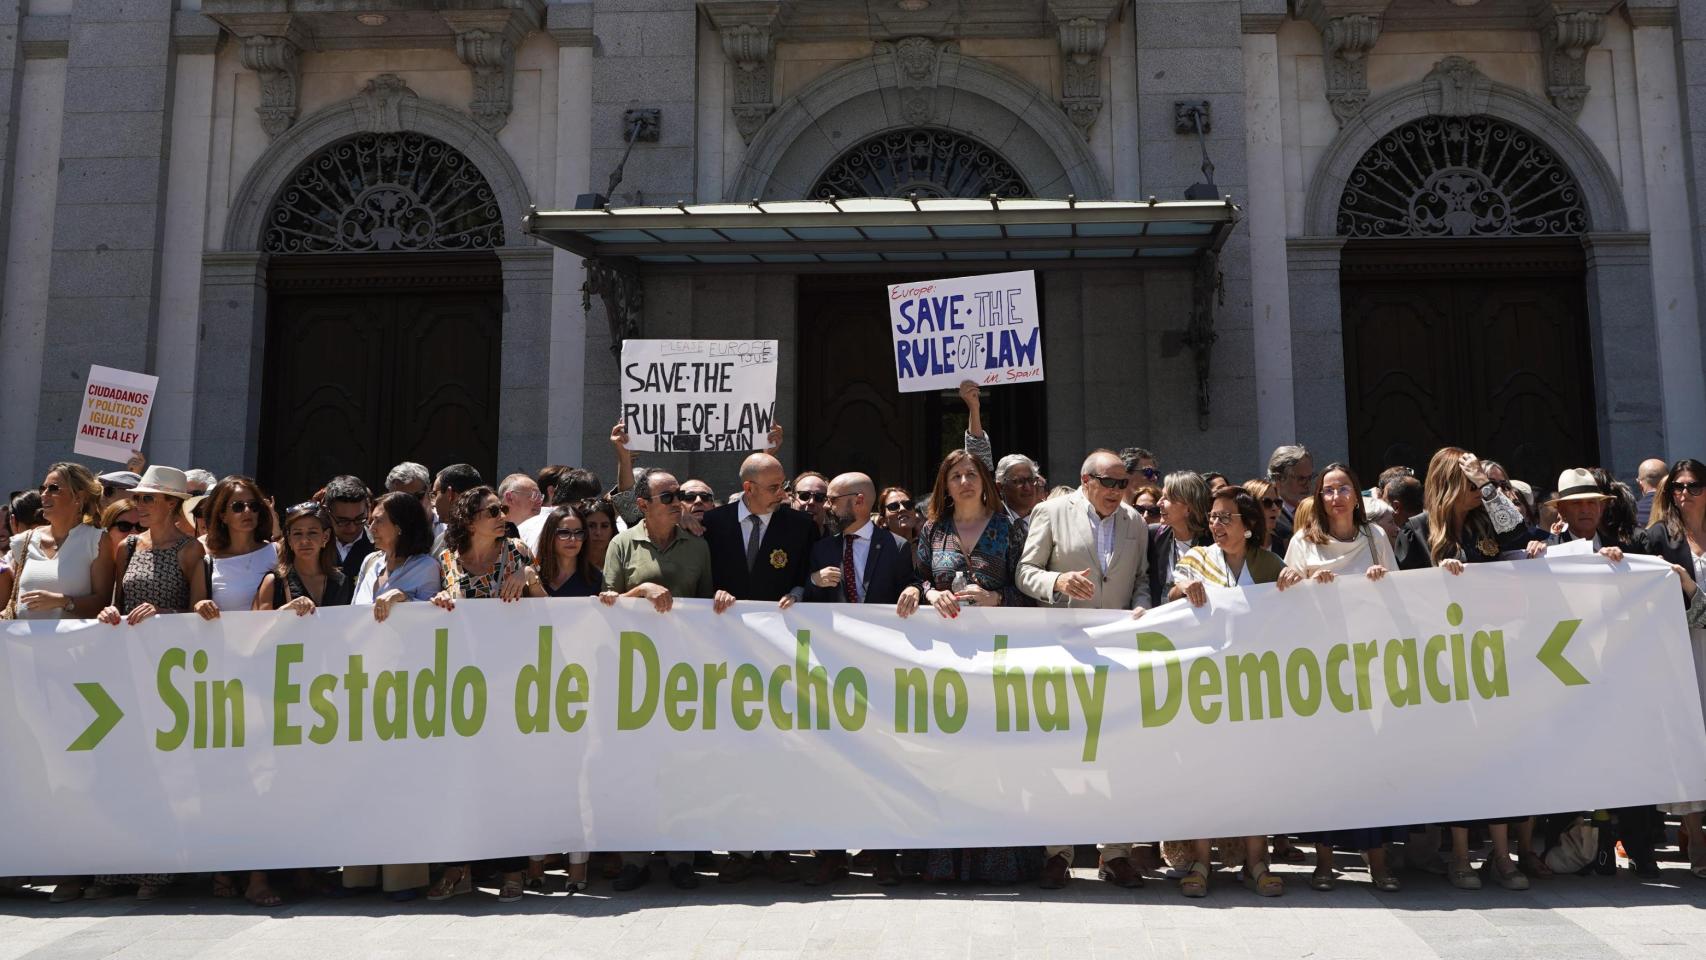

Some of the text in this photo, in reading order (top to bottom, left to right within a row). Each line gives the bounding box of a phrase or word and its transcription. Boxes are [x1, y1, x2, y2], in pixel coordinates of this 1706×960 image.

[891, 285, 937, 299] Europe:
[659, 340, 772, 357] PLEASE EUROPE
[983, 367, 1040, 384] in Spain
[88, 384, 149, 405] CIUDADANOS
[87, 398, 144, 417] Y POLÍTICOS
[90, 411, 136, 430] IGUALES
[81, 423, 139, 444] ANTE LA LEY
[654, 434, 753, 451] IN SPAIN
[156, 602, 1510, 762] Sin Estado de Derecho no hay Democracia
